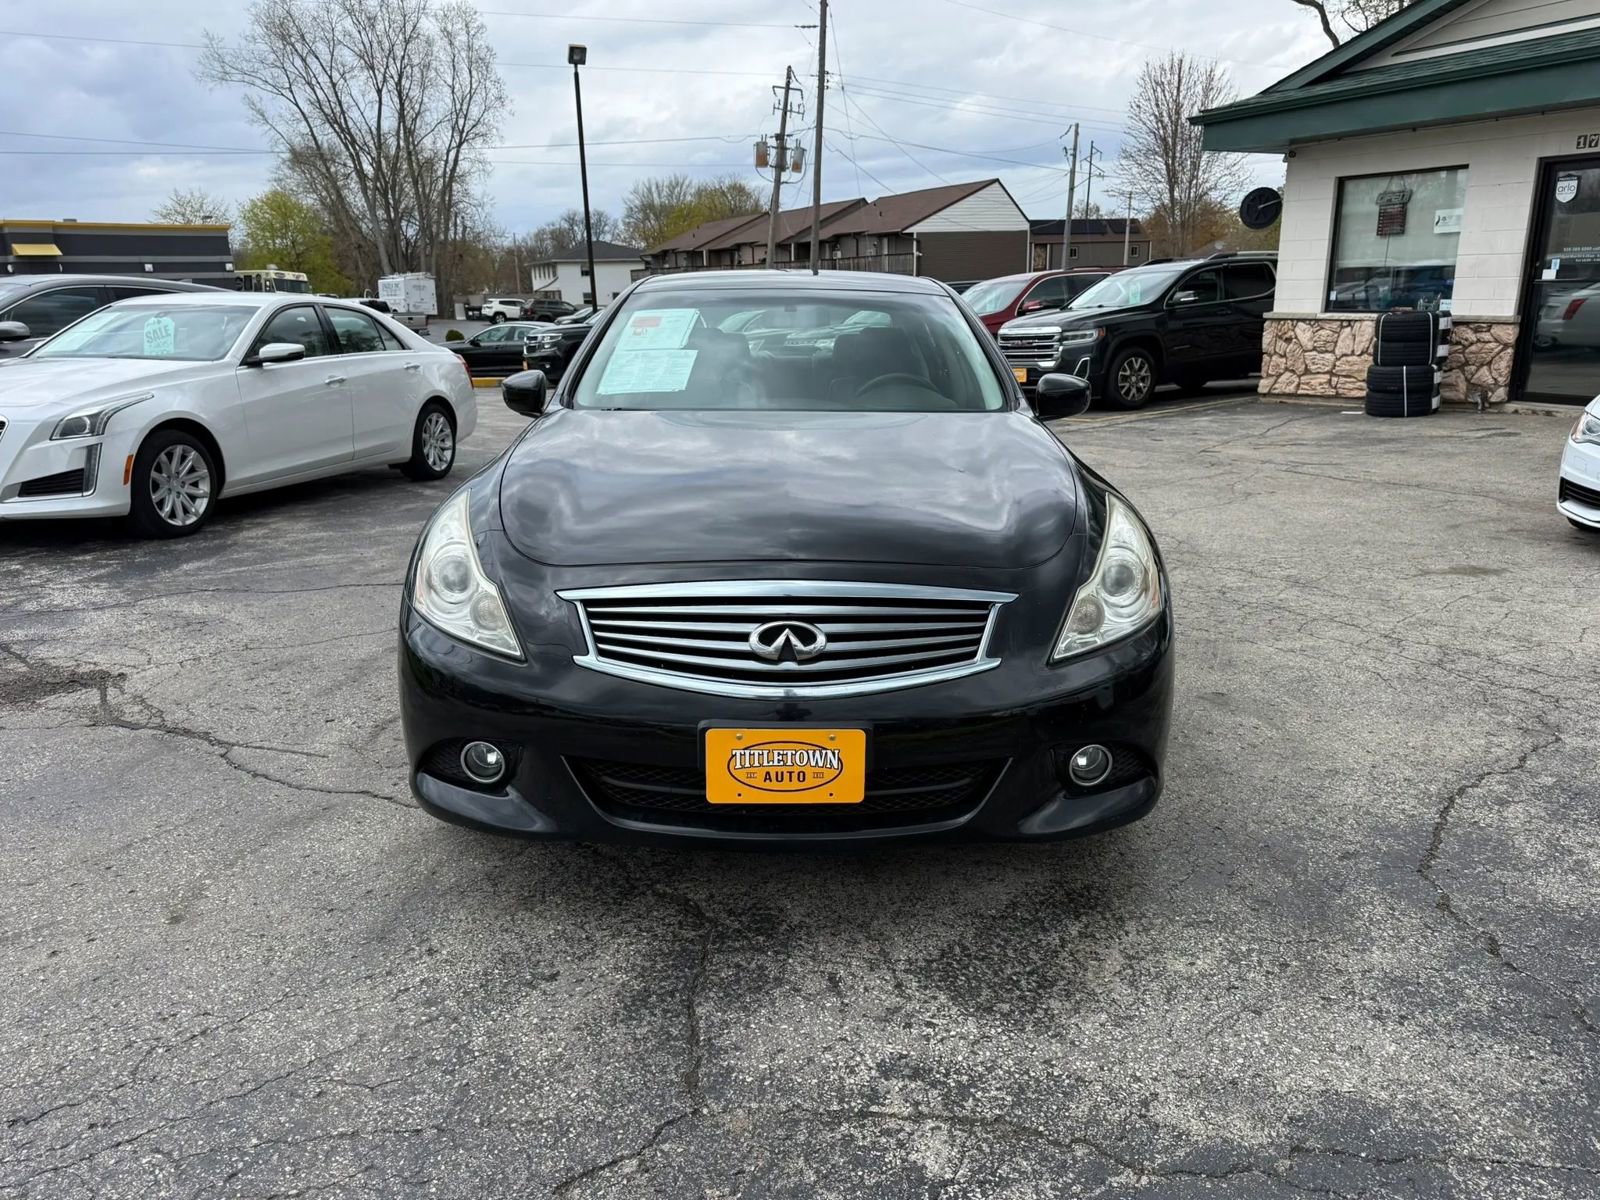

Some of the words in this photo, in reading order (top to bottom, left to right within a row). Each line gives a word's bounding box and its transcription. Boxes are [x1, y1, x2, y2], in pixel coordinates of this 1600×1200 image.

[1557, 183, 1576, 193] arlo
[145, 325, 171, 343] SALE
[732, 749, 840, 770] TITLETOWN
[763, 770, 806, 783] AUTO
